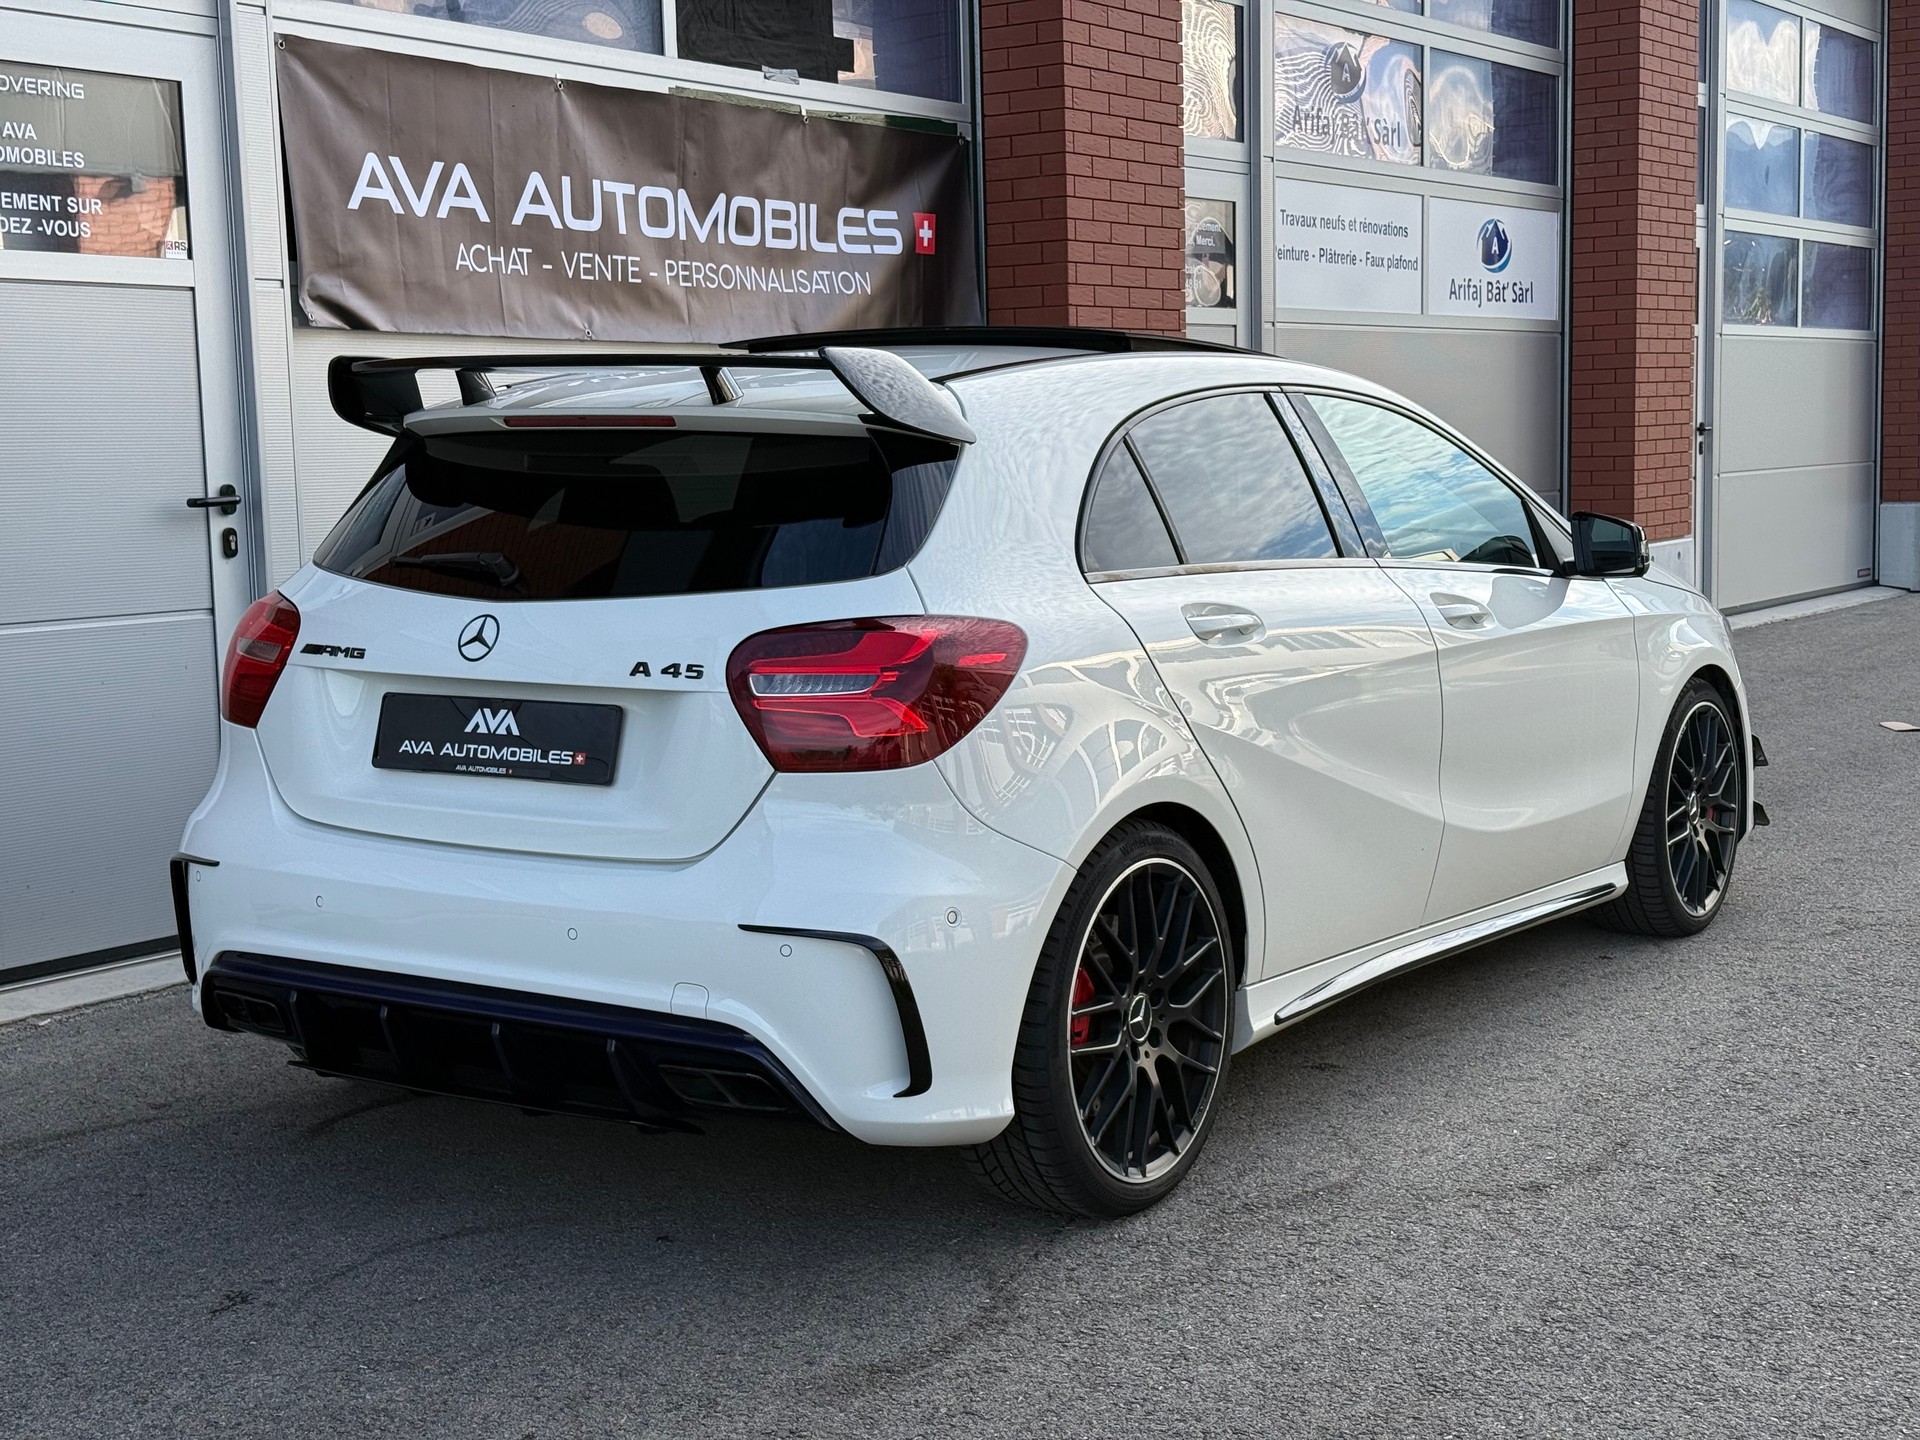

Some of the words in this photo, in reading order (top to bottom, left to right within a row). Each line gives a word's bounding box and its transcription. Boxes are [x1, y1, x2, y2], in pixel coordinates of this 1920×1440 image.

[2, 121, 38, 140] AVA
[1374, 118, 1401, 147] Sàrl
[1, 192, 62, 212] EMENT
[67, 197, 103, 215] SUR
[347, 152, 491, 223] AVA
[511, 171, 903, 255] AUTOMOBILES
[1280, 209, 1317, 228] Travaux
[1320, 215, 1346, 231] neufs
[1348, 217, 1357, 232] et
[1359, 217, 1409, 238] rénovations
[456, 243, 532, 276] ACHAT
[561, 251, 642, 283] VENTE
[665, 259, 871, 295] PERSONNALISATION
[1319, 247, 1357, 266] Plâtrerie
[1365, 252, 1385, 268] Faux
[1387, 254, 1418, 272] plafond
[1449, 278, 1482, 308] Arifaj
[1512, 281, 1534, 303] Sàrl
[319, 645, 366, 660] AMG
[629, 661, 651, 677] A
[660, 663, 704, 679] 45
[464, 708, 520, 736] AVA
[399, 740, 434, 756] AVA
[440, 743, 573, 765] AUTOMOBILES
[455, 764, 467, 772] AVA
[468, 765, 507, 775] AUTOMOBILES
